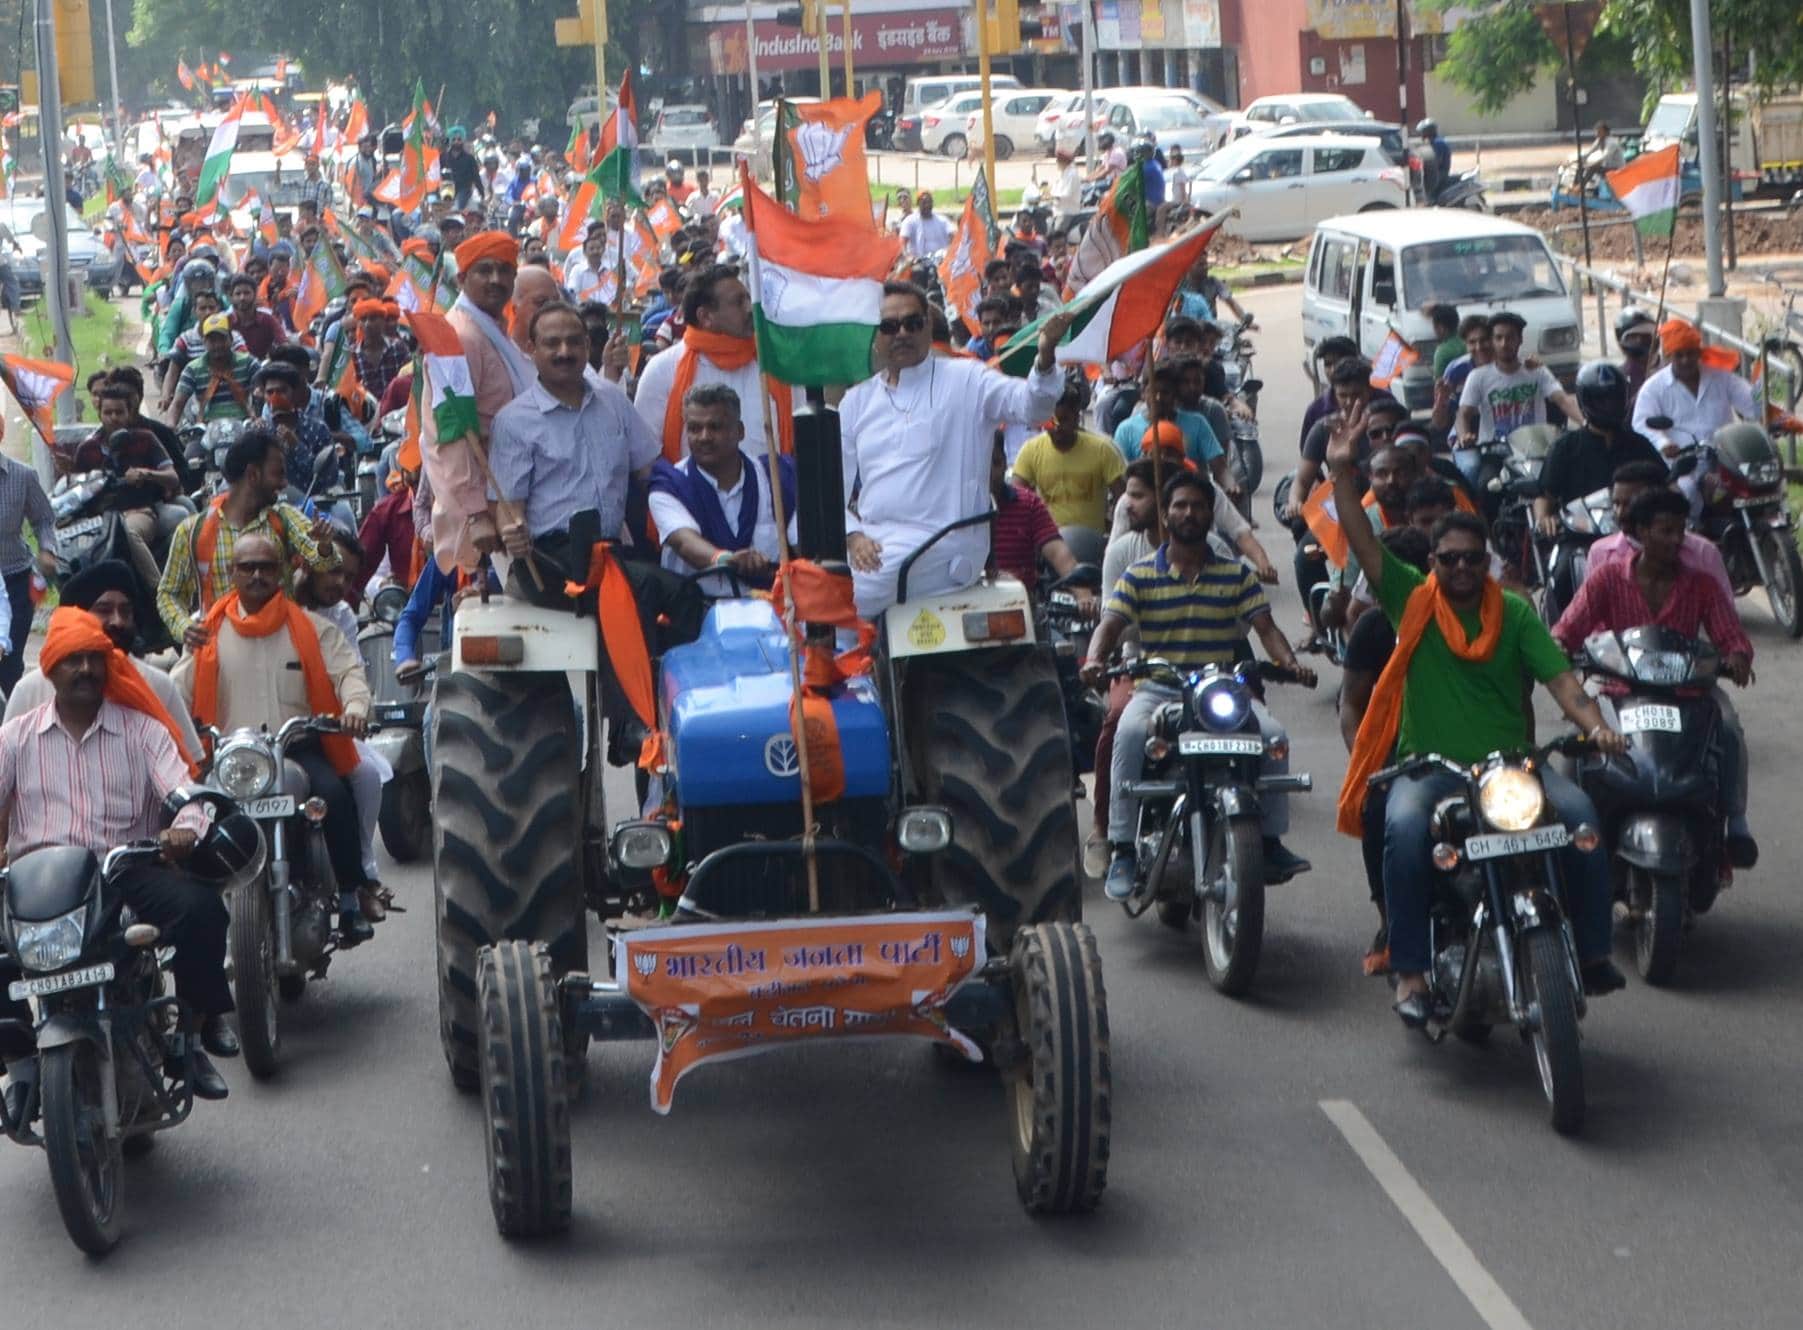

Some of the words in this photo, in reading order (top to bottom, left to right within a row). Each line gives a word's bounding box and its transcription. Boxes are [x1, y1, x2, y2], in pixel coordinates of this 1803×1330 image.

[665, 943, 765, 977] भारतीय
[783, 942, 865, 968] जनता
[878, 931, 942, 966] पार्टी
